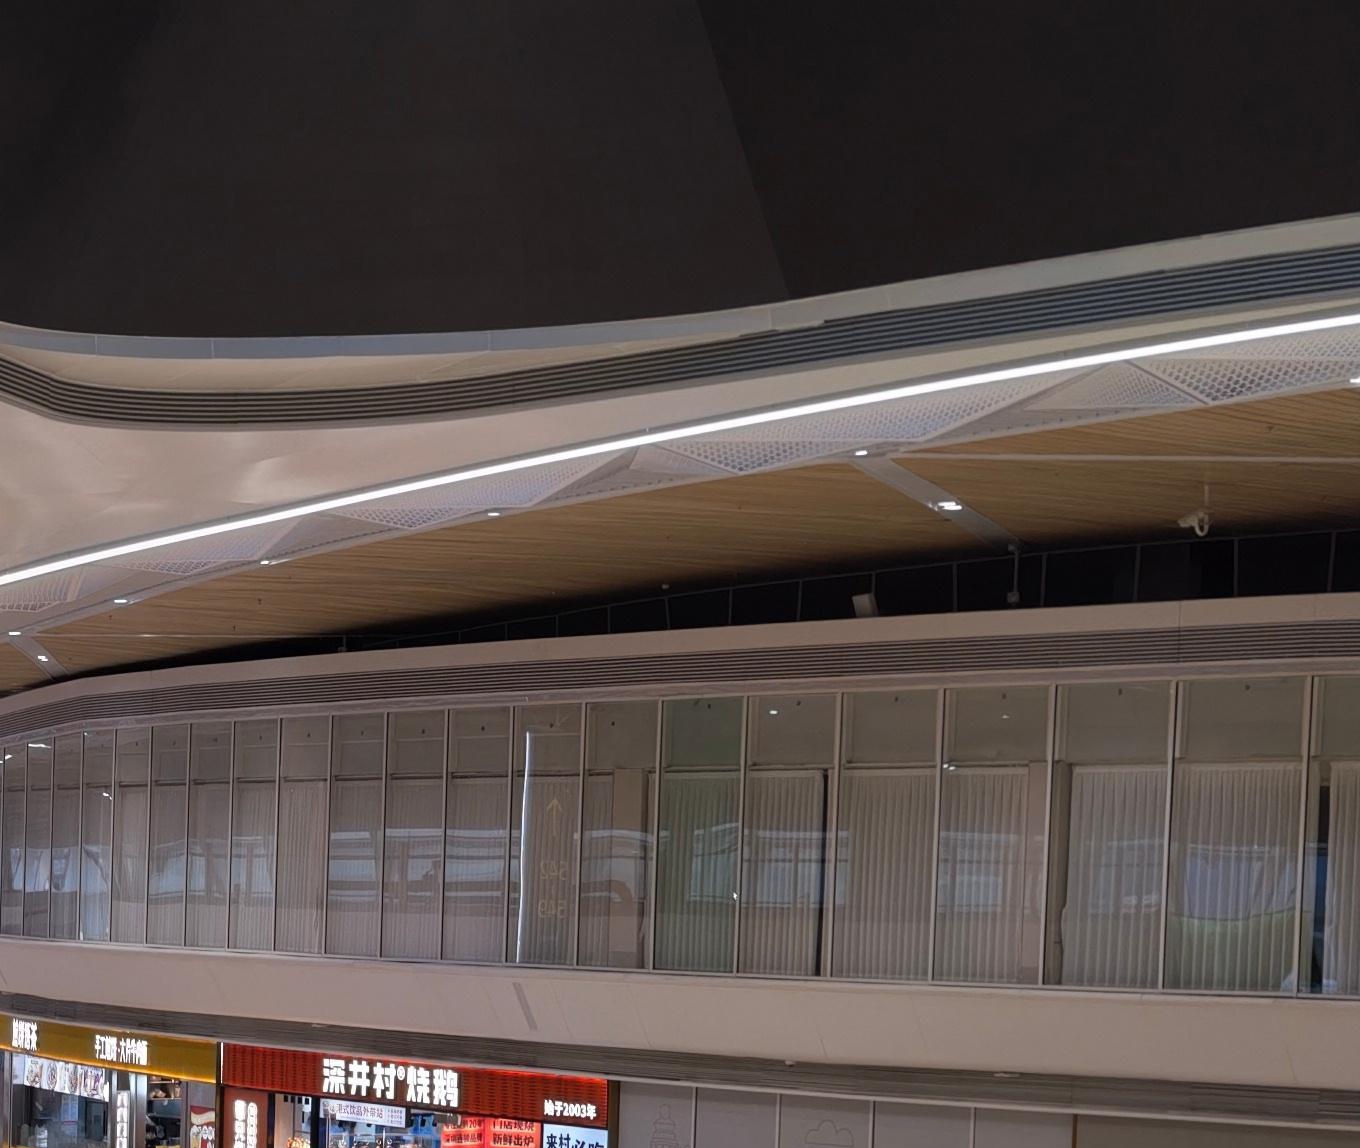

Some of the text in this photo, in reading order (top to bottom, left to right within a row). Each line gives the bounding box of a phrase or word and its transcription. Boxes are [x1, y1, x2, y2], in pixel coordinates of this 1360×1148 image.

[544, 1099, 597, 1120] 始于2003年
[492, 1133, 534, 1146] 新鲜出炉
